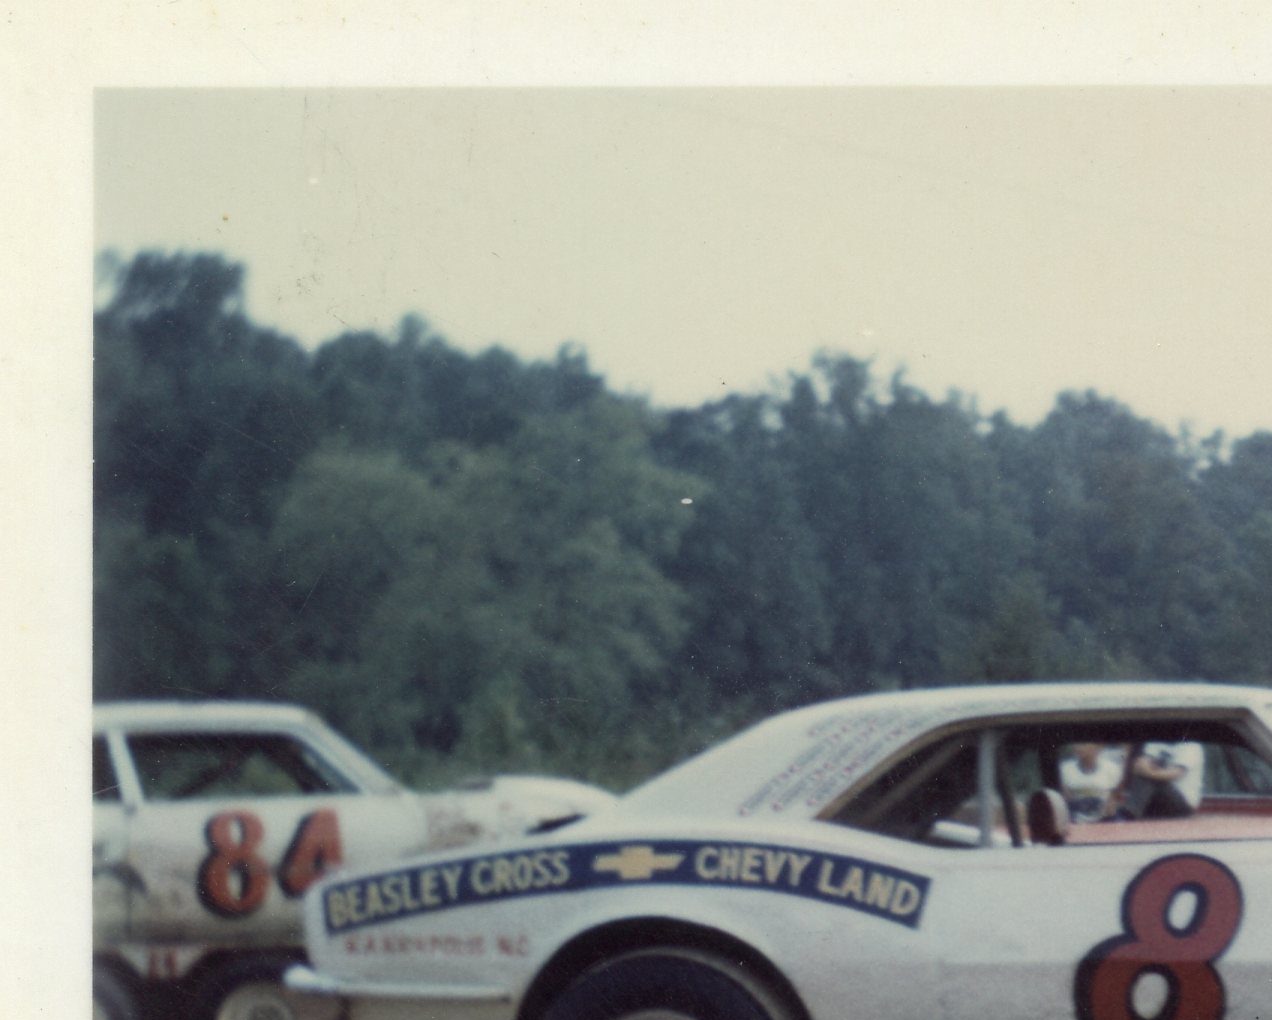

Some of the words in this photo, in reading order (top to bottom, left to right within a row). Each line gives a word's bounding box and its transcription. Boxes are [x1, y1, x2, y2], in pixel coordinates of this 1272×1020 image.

[196, 807, 343, 920] 84
[328, 864, 463, 929] BEASLEY
[470, 851, 570, 895] CROSS
[695, 845, 813, 887] CHEVY
[817, 858, 921, 916] LAND
